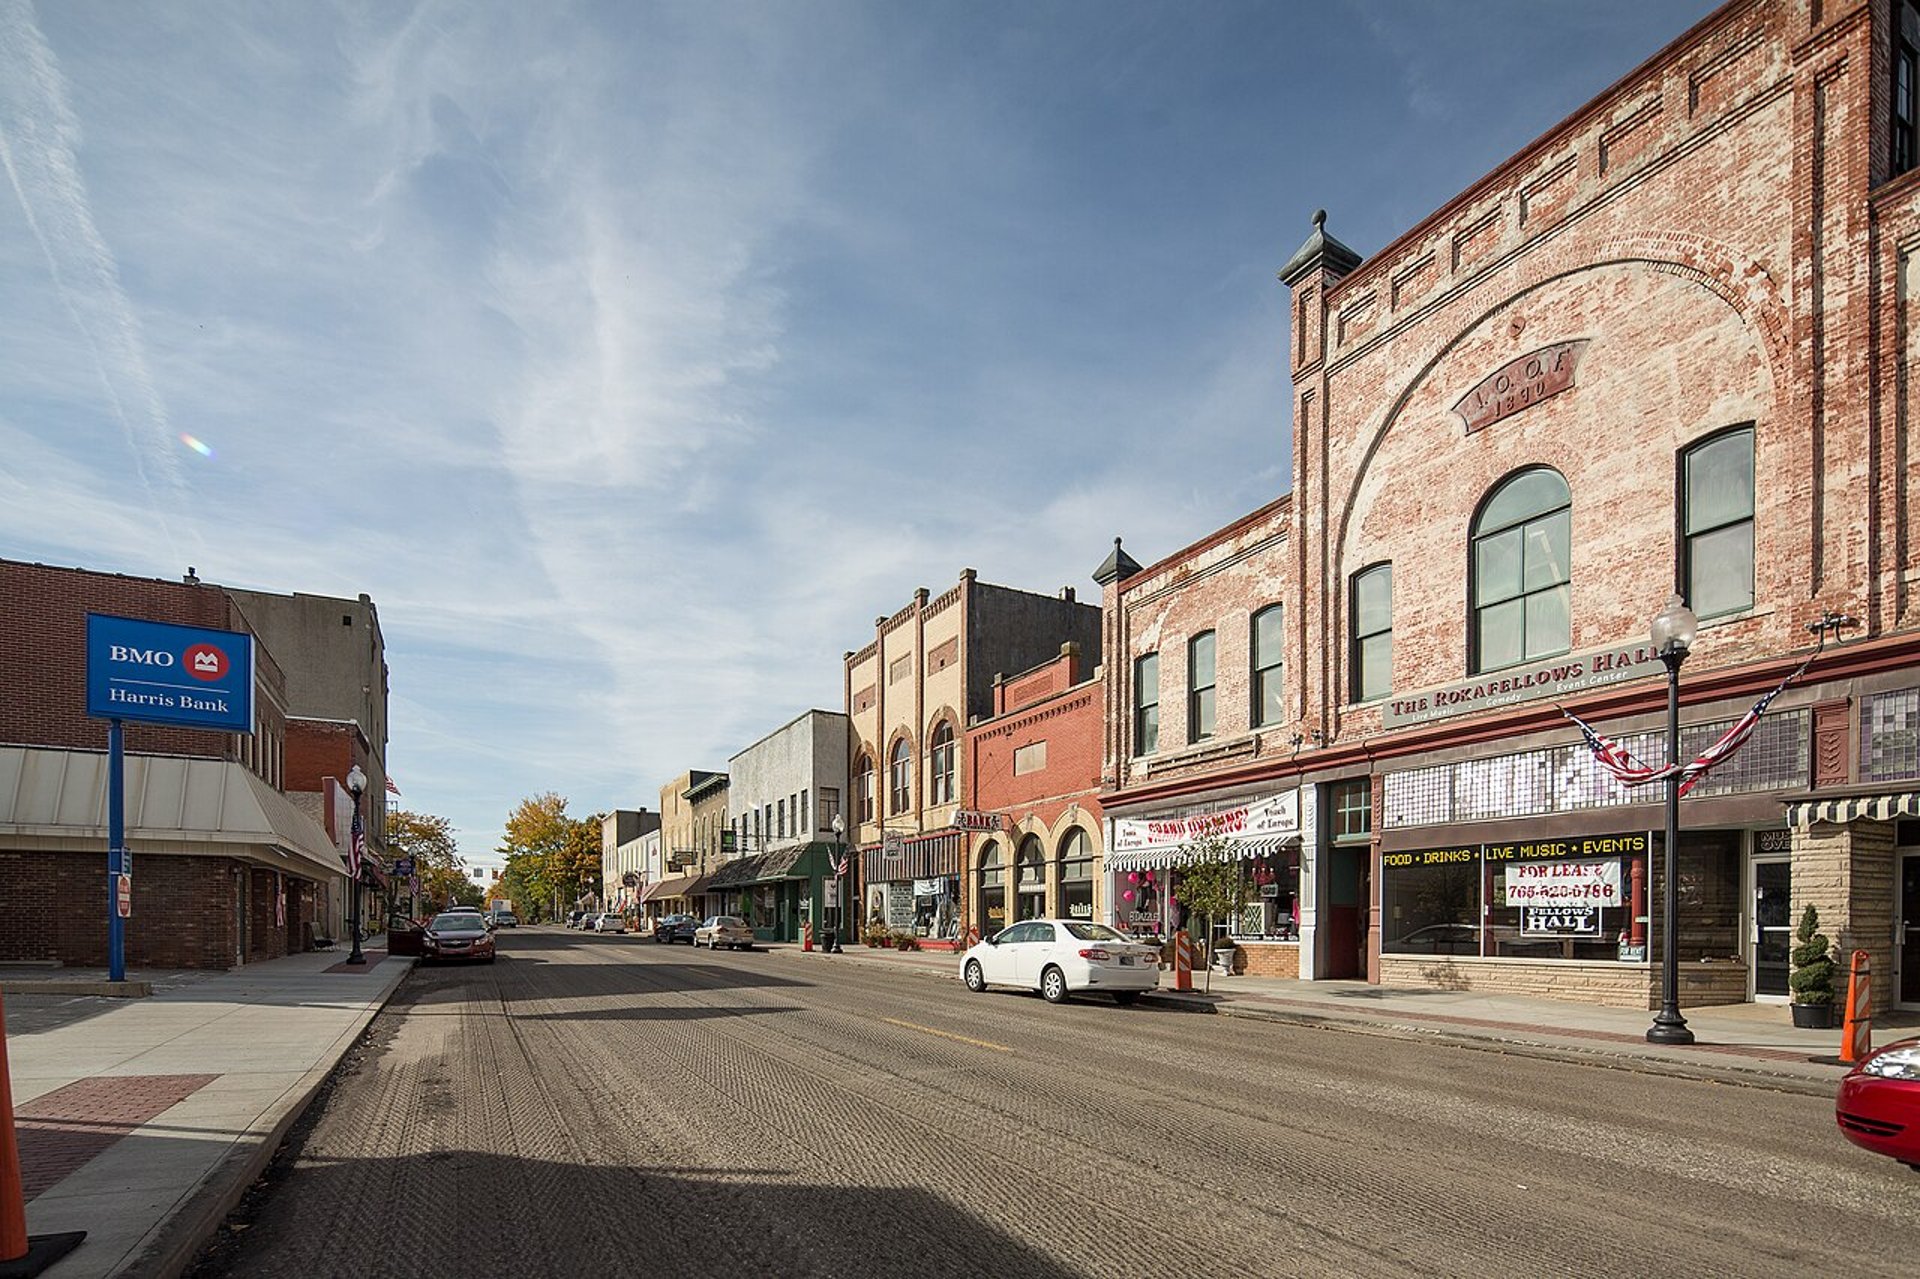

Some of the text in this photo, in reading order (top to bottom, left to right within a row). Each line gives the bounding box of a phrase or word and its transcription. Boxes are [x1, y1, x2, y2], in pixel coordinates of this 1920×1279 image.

[109, 645, 175, 667] BMO
[1391, 644, 1662, 716] THE ROKAFELLOWS HALL
[1485, 691, 1522, 707] Comedy
[1556, 678, 1586, 693] Event
[1589, 670, 1628, 685] Center
[109, 688, 229, 713] Harris Bank
[966, 813, 992, 828] BANK
[1384, 837, 1645, 867] FOOD DRINKS LIVE MUSIC EVENTS
[1518, 863, 1604, 878] FOR LEASE
[1528, 906, 1595, 916] FELLOWS
[1526, 915, 1596, 932] HALL
